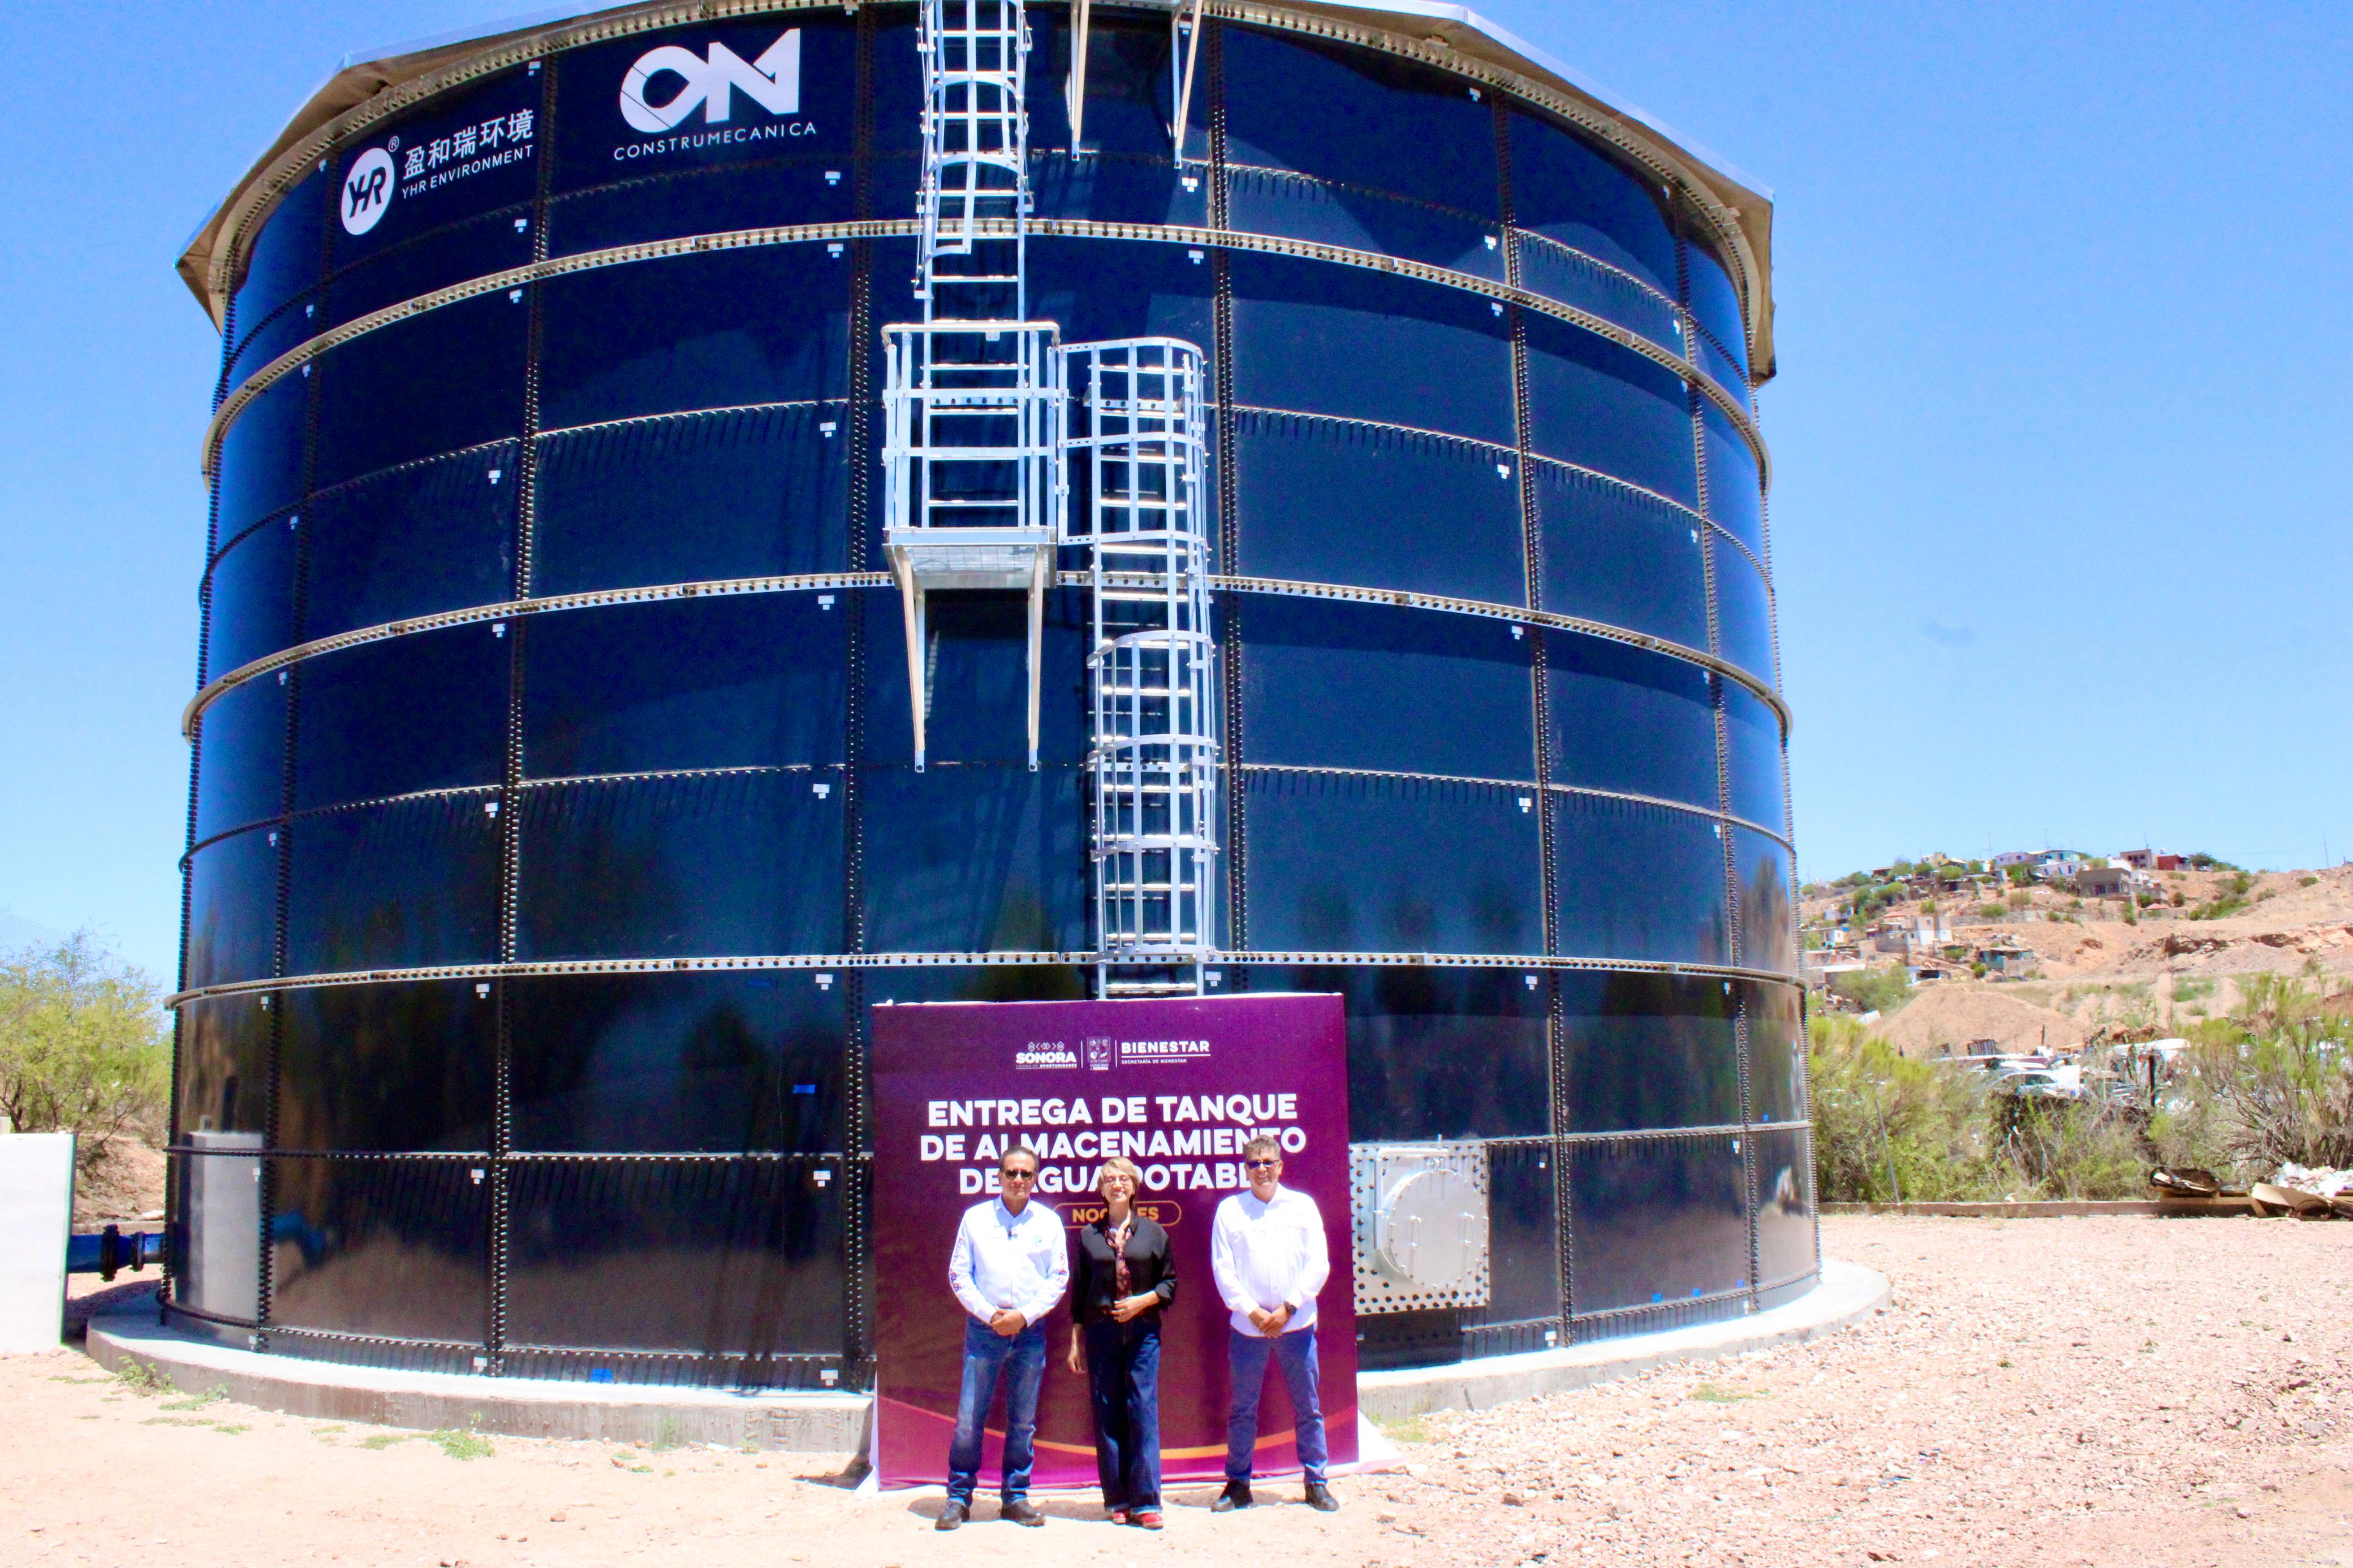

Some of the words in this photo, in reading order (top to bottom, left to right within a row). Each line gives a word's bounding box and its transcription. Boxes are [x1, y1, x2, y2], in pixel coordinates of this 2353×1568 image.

[403, 109, 533, 180] 盈和瑞环境
[614, 122, 816, 161] CONSTRUMECANICA
[402, 180, 427, 199] YHR
[430, 145, 533, 189] ENVIRONMENT
[1016, 1051, 1077, 1064] SONORA
[1121, 1040, 1210, 1054] BIENESTAR
[928, 1098, 1093, 1127] ENTREGA
[1101, 1096, 1147, 1124] DE
[1156, 1093, 1298, 1126] TANQUE
[921, 1134, 966, 1161] DE
[960, 1168, 1003, 1194] DE
[1031, 1166, 1102, 1194] GU
[1134, 1161, 1252, 1191] OTABL
[1072, 1207, 1159, 1223] NOES
